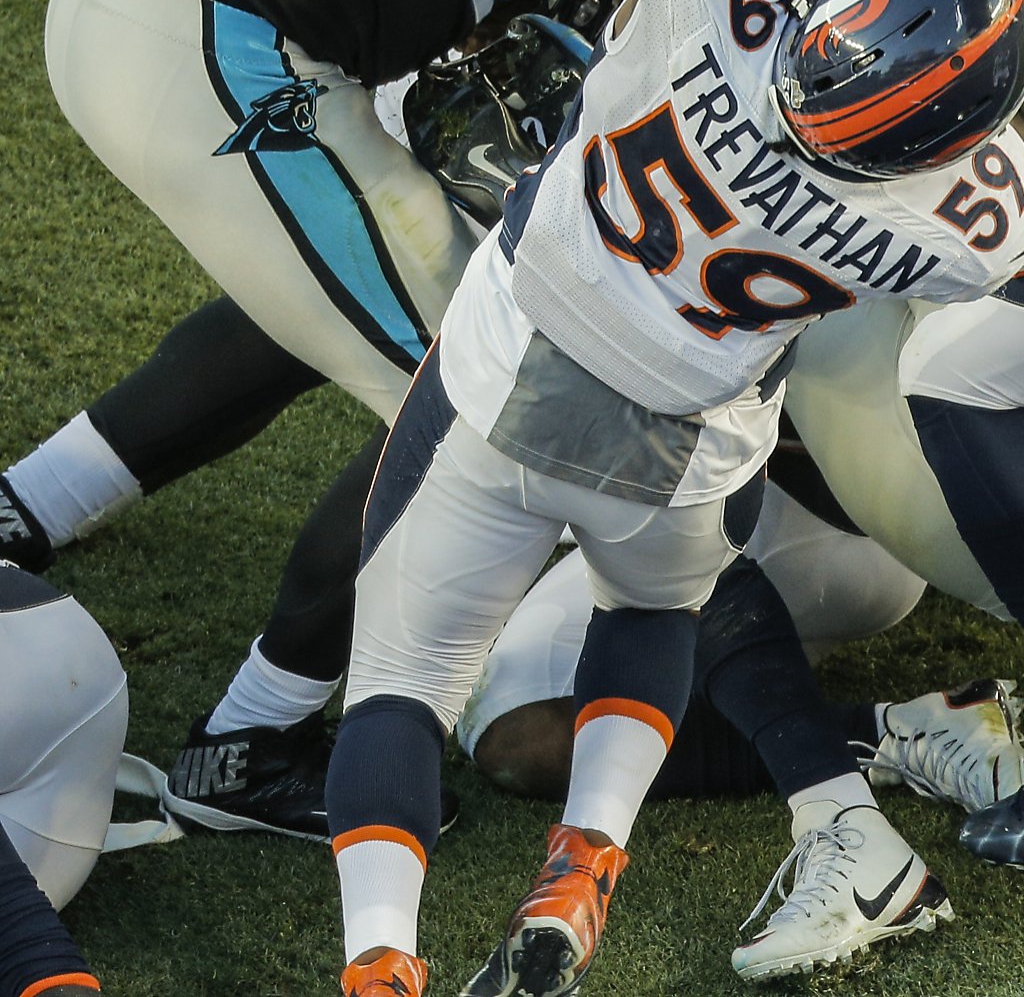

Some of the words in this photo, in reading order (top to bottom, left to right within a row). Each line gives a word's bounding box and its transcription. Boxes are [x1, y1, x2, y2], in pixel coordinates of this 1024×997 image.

[583, 100, 857, 340] 59
[671, 43, 940, 293] TREVATHAN
[169, 741, 250, 798] NIKE
